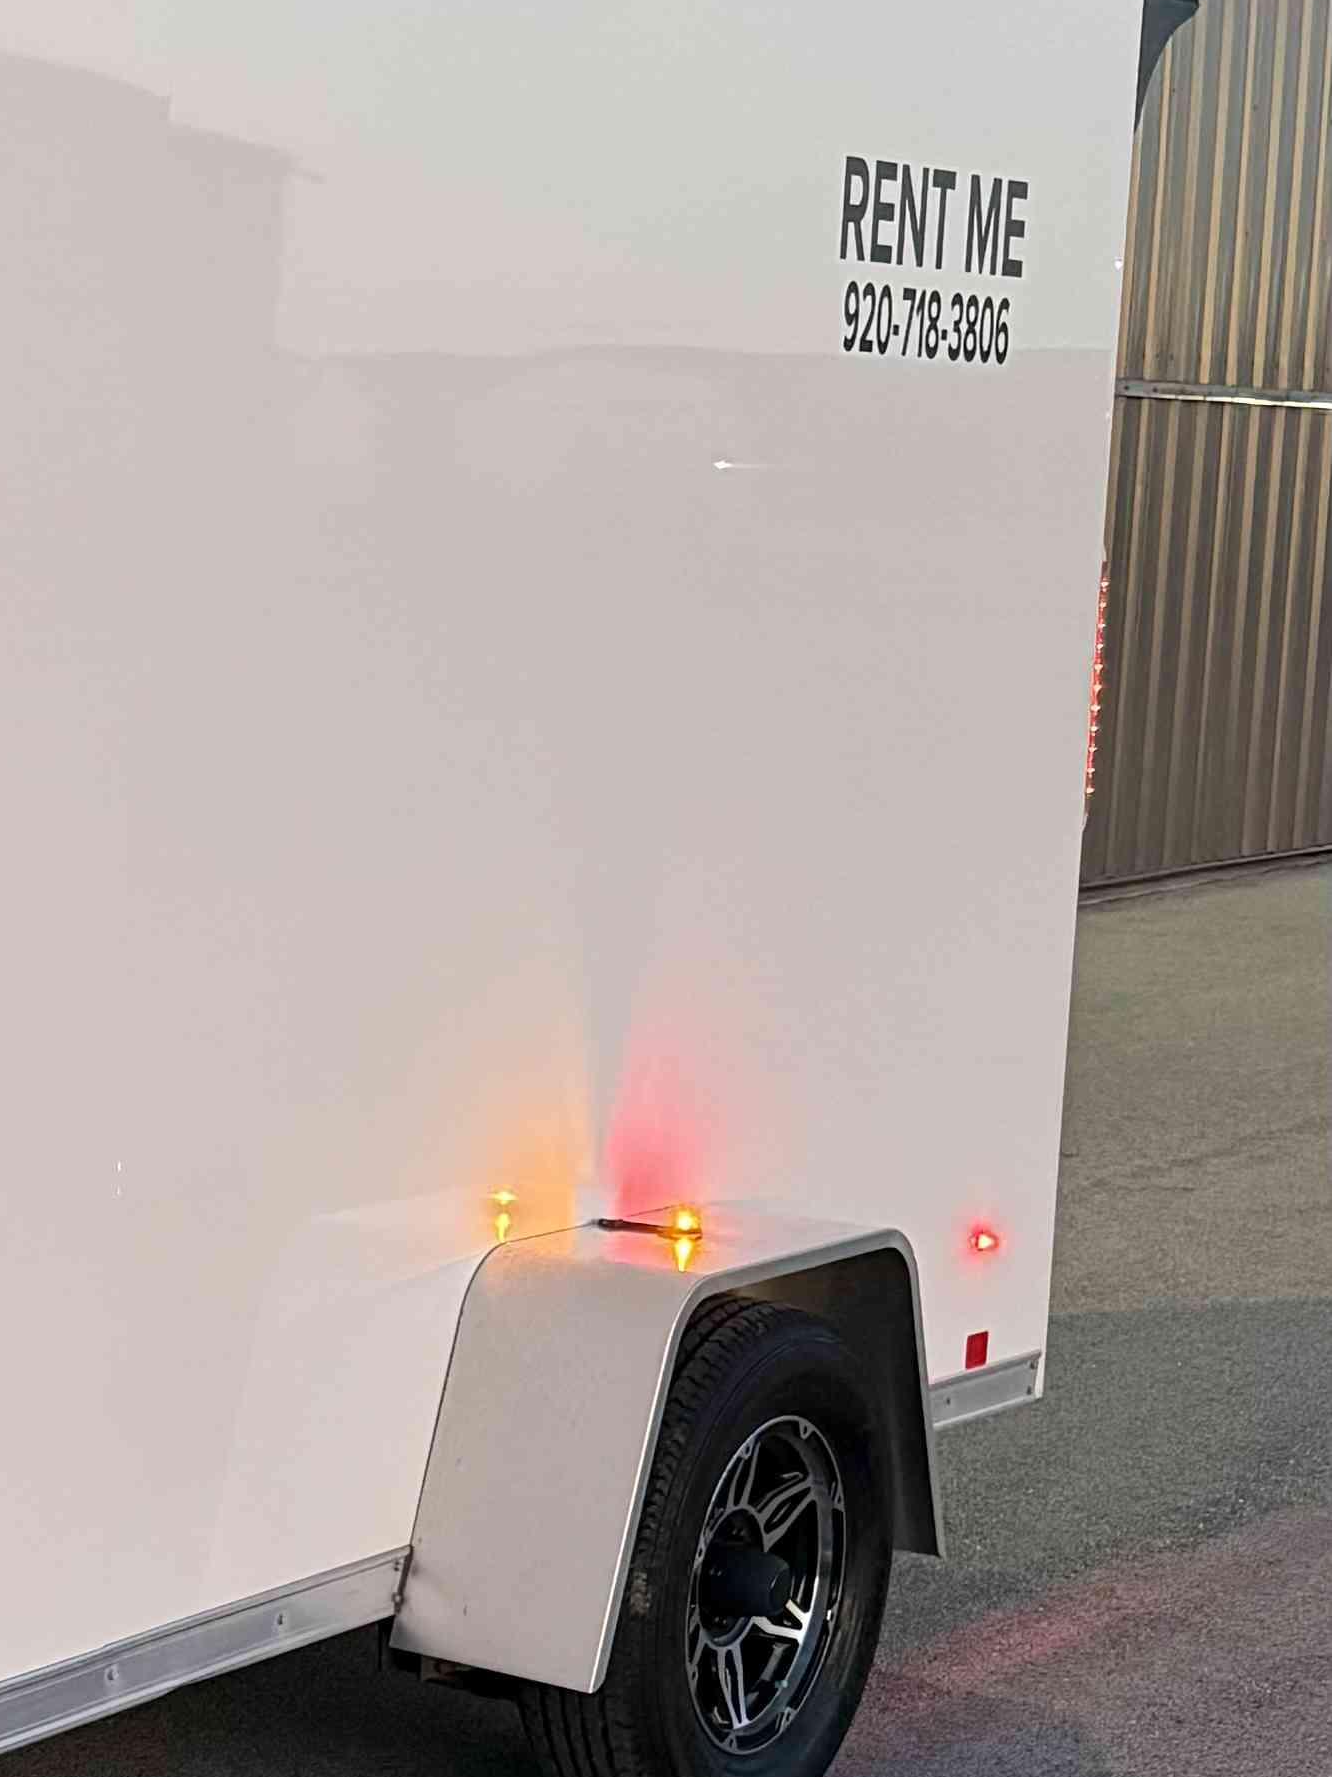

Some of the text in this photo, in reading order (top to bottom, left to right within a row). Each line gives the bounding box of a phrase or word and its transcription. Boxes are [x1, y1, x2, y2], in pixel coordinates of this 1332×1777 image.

[840, 155, 1029, 278] RENT ME
[843, 280, 1011, 365] 920-718-3806
